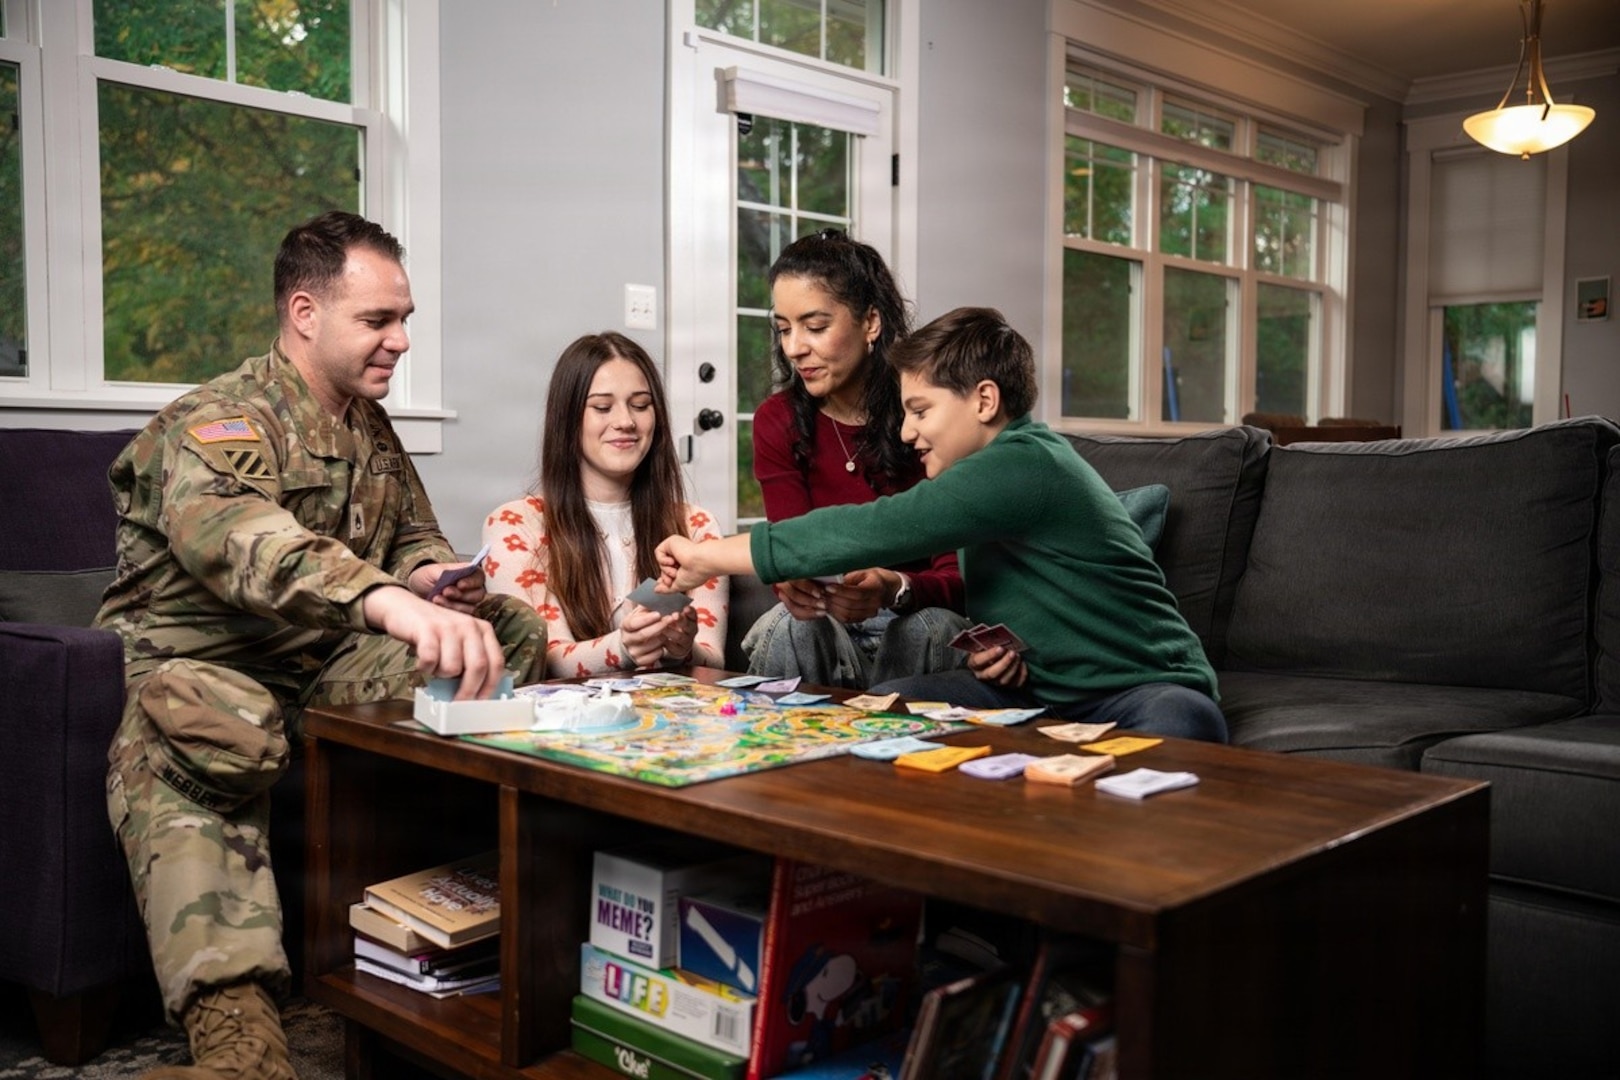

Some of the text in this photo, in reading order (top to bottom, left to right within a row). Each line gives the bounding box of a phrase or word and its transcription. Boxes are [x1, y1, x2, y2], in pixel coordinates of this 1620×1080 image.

[419, 888, 463, 911] Have
[598, 884, 622, 903] WHAT
[624, 892, 636, 908] DO
[637, 896, 655, 914] YOU
[598, 898, 654, 941] MEME?
[606, 964, 663, 1014] LIFE
